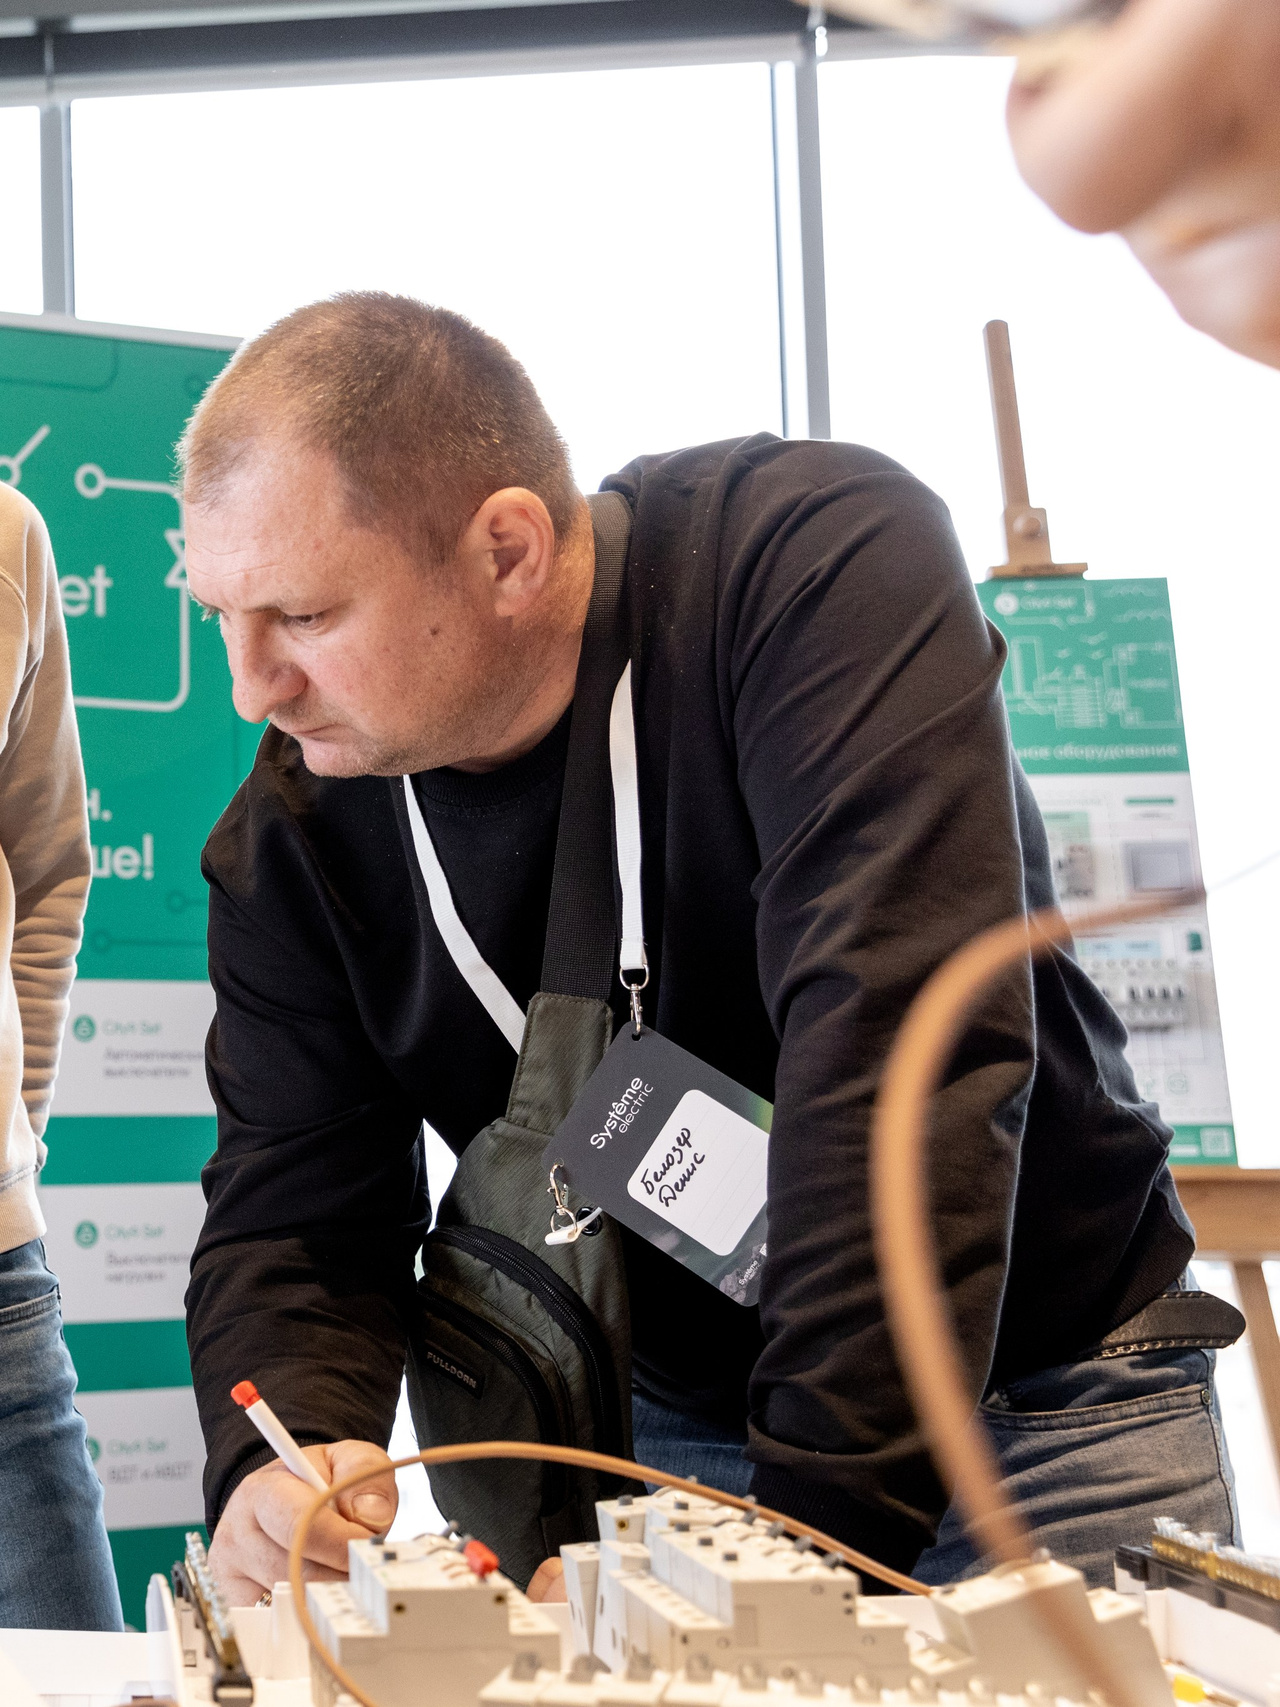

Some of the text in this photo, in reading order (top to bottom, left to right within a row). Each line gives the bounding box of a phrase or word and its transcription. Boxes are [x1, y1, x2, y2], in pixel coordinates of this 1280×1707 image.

[59, 564, 114, 618] et
[589, 1077, 643, 1150] Systême
[618, 1083, 654, 1134] electric
[658, 1152, 706, 1208] Денис
